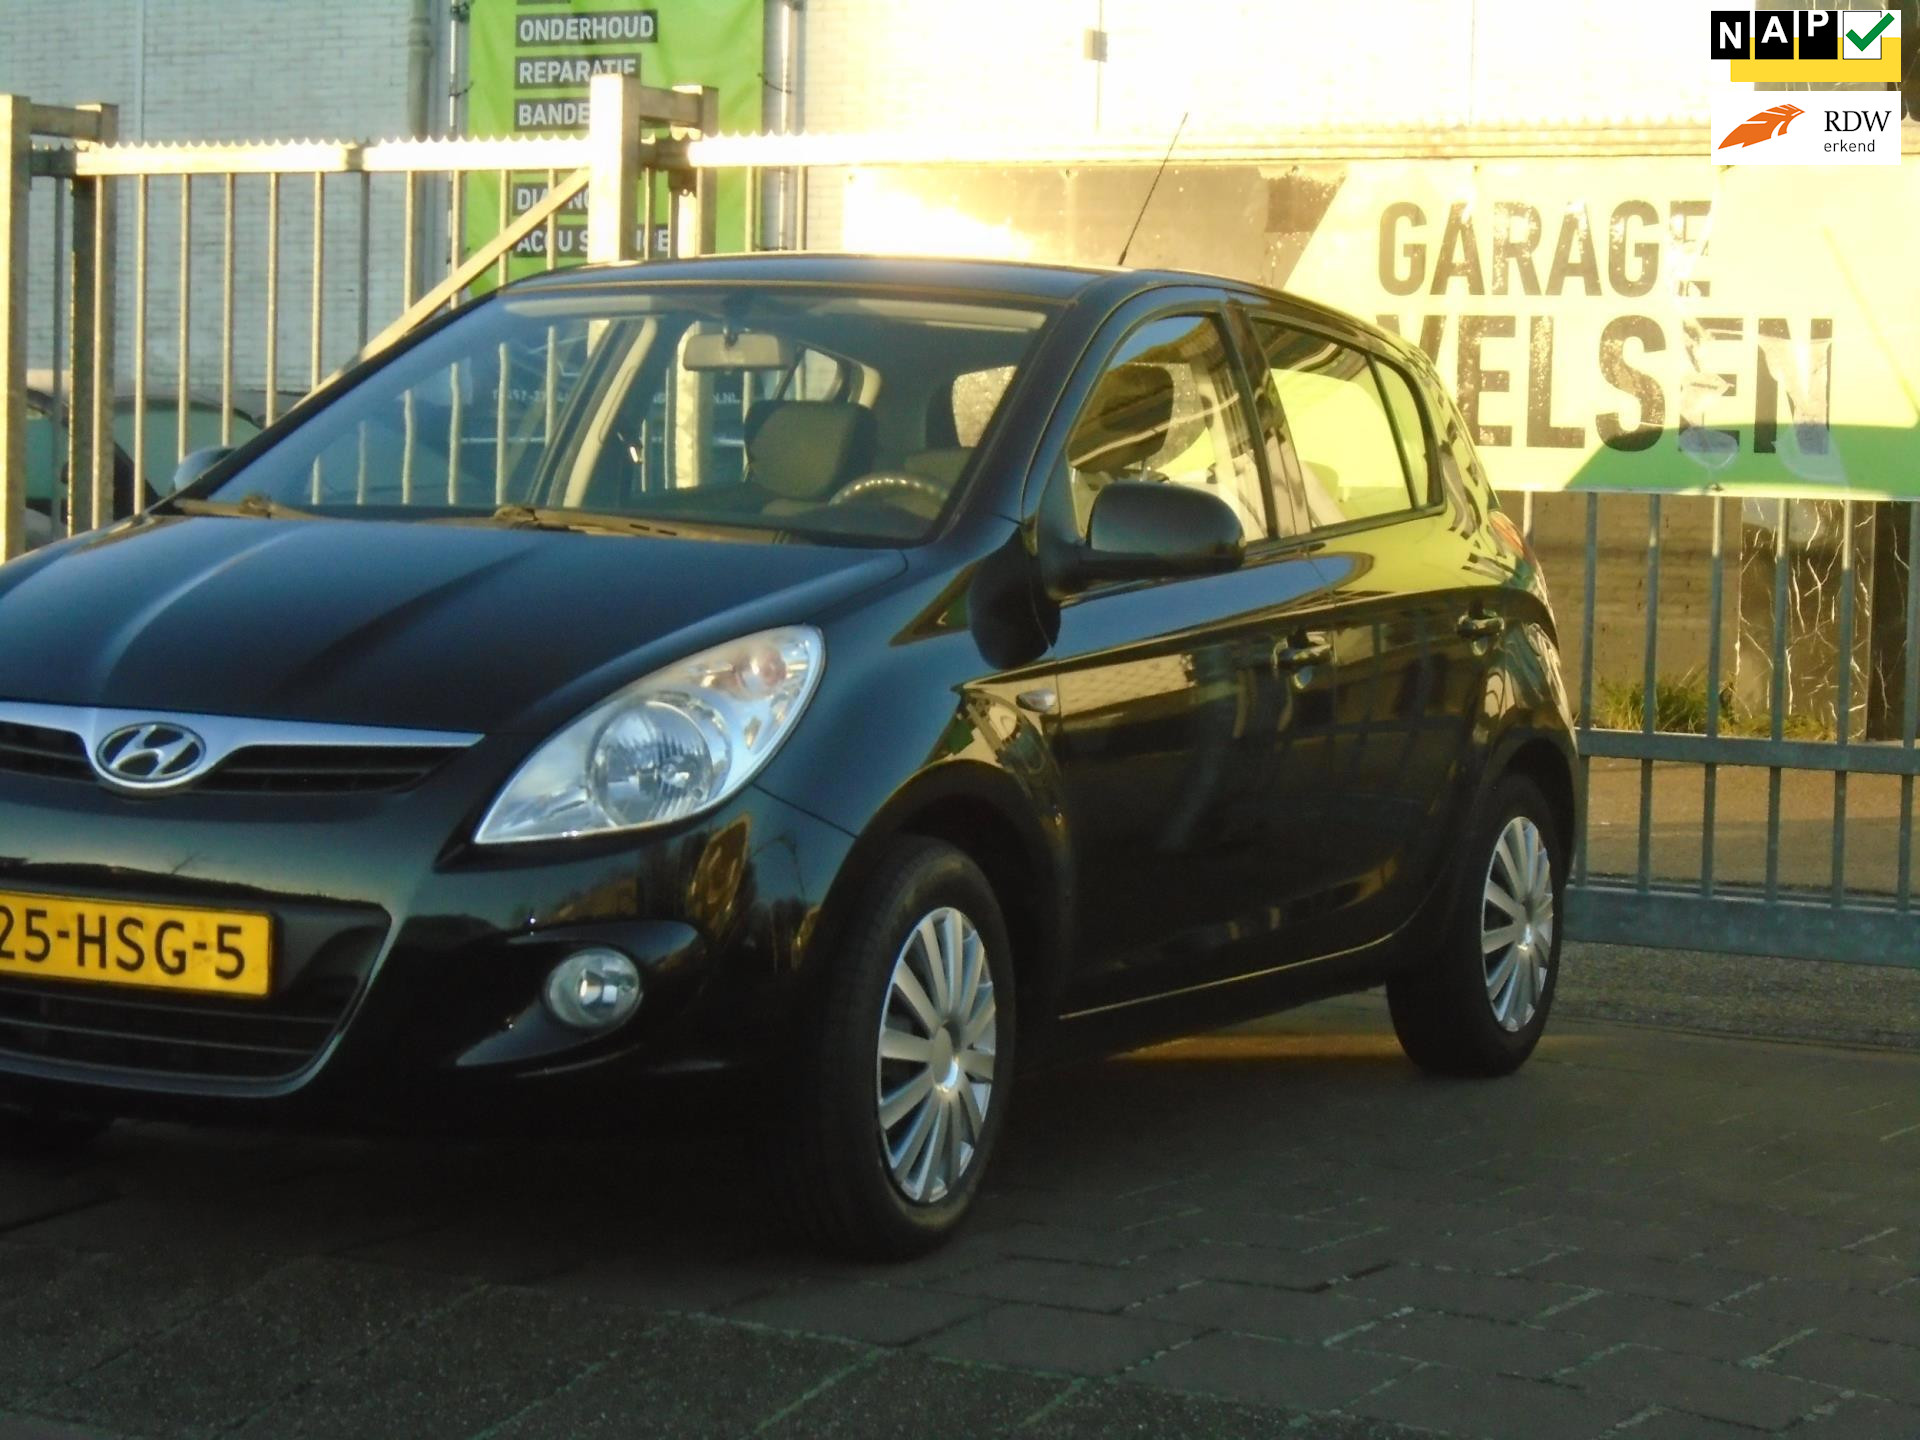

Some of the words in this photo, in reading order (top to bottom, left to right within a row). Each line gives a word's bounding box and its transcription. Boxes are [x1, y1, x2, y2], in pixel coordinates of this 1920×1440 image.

[519, 15, 654, 42] ONDERHOUD
[519, 58, 636, 84] REPARATIE
[518, 103, 590, 126] BANDE
[517, 230, 573, 253] ACU
[0, 905, 246, 980] 25-HSG-5
